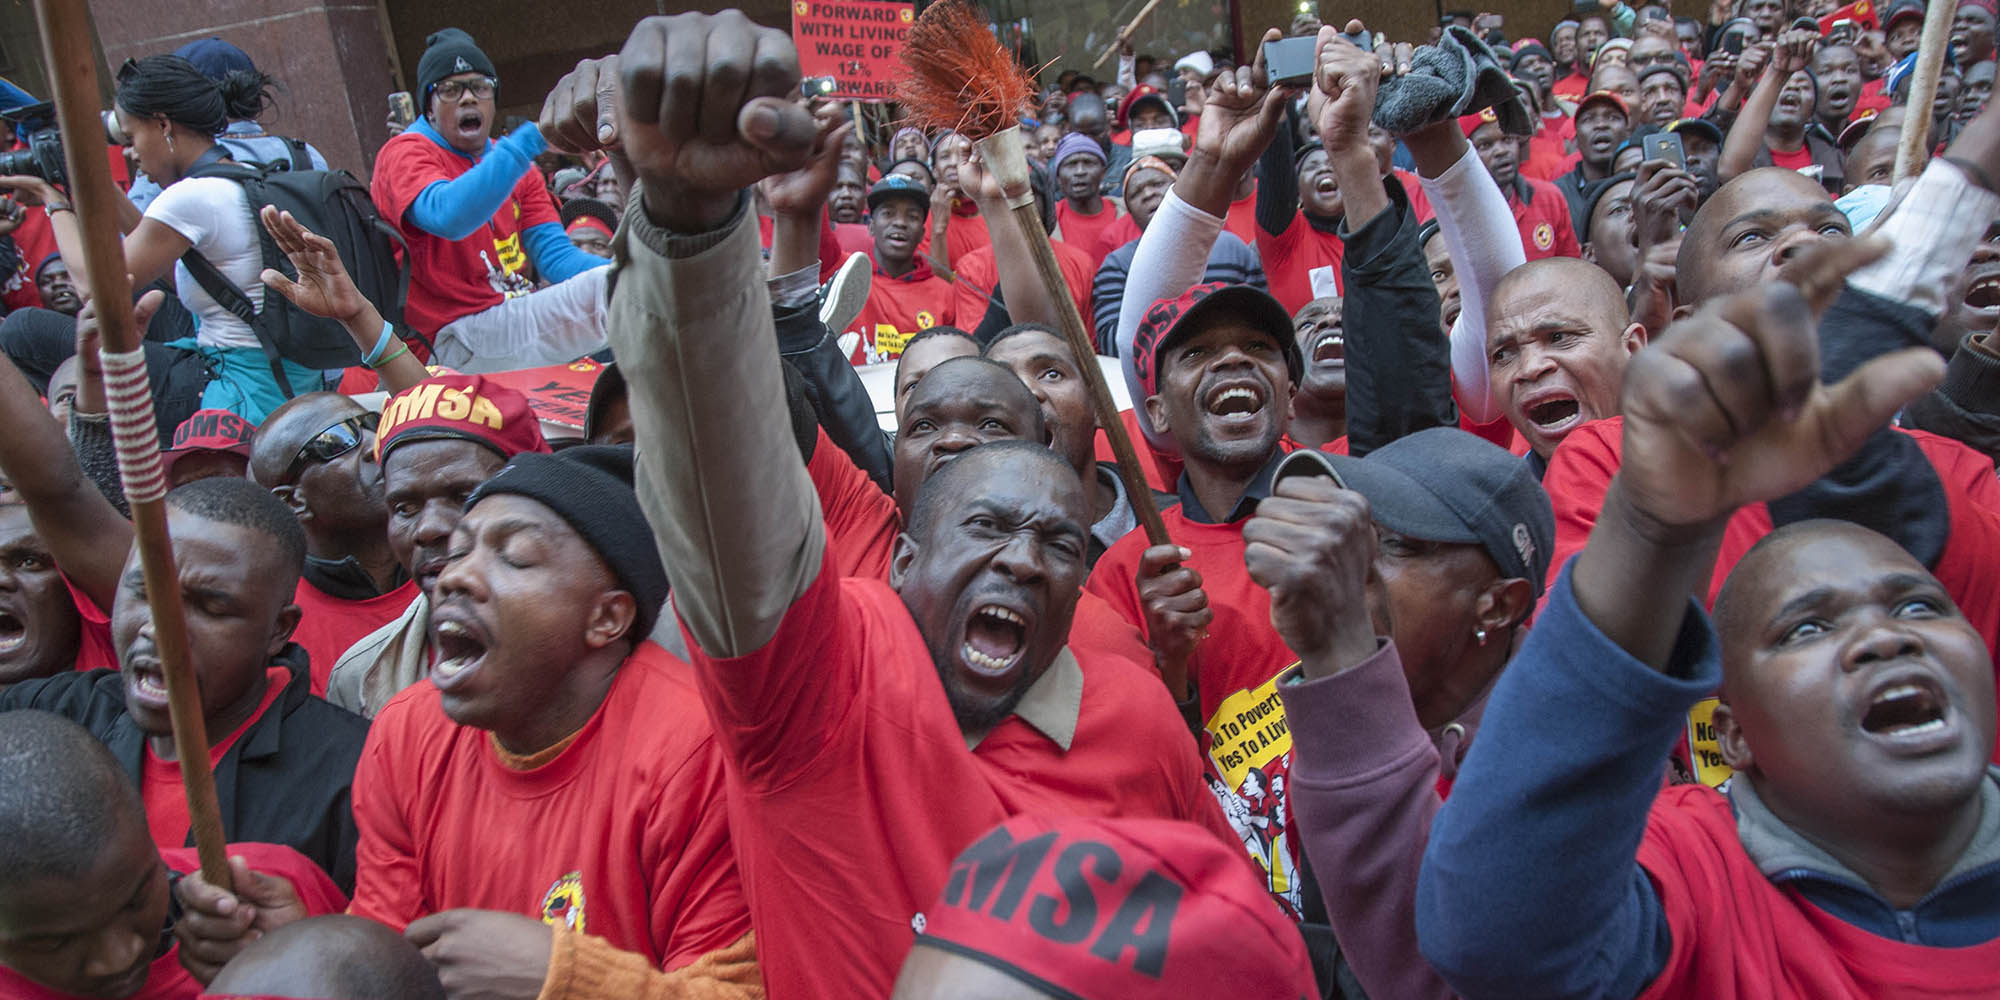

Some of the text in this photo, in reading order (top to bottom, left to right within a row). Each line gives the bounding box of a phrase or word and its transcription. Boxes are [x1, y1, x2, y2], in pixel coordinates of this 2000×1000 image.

[811, 3, 896, 23] FORWARD
[800, 21, 845, 39] WITH
[815, 41, 893, 59] WAGE OF
[1236, 691, 1282, 731] Povert
[1218, 749, 1245, 772] Yes
[1239, 739, 1260, 758] To
[1255, 729, 1271, 749] A
